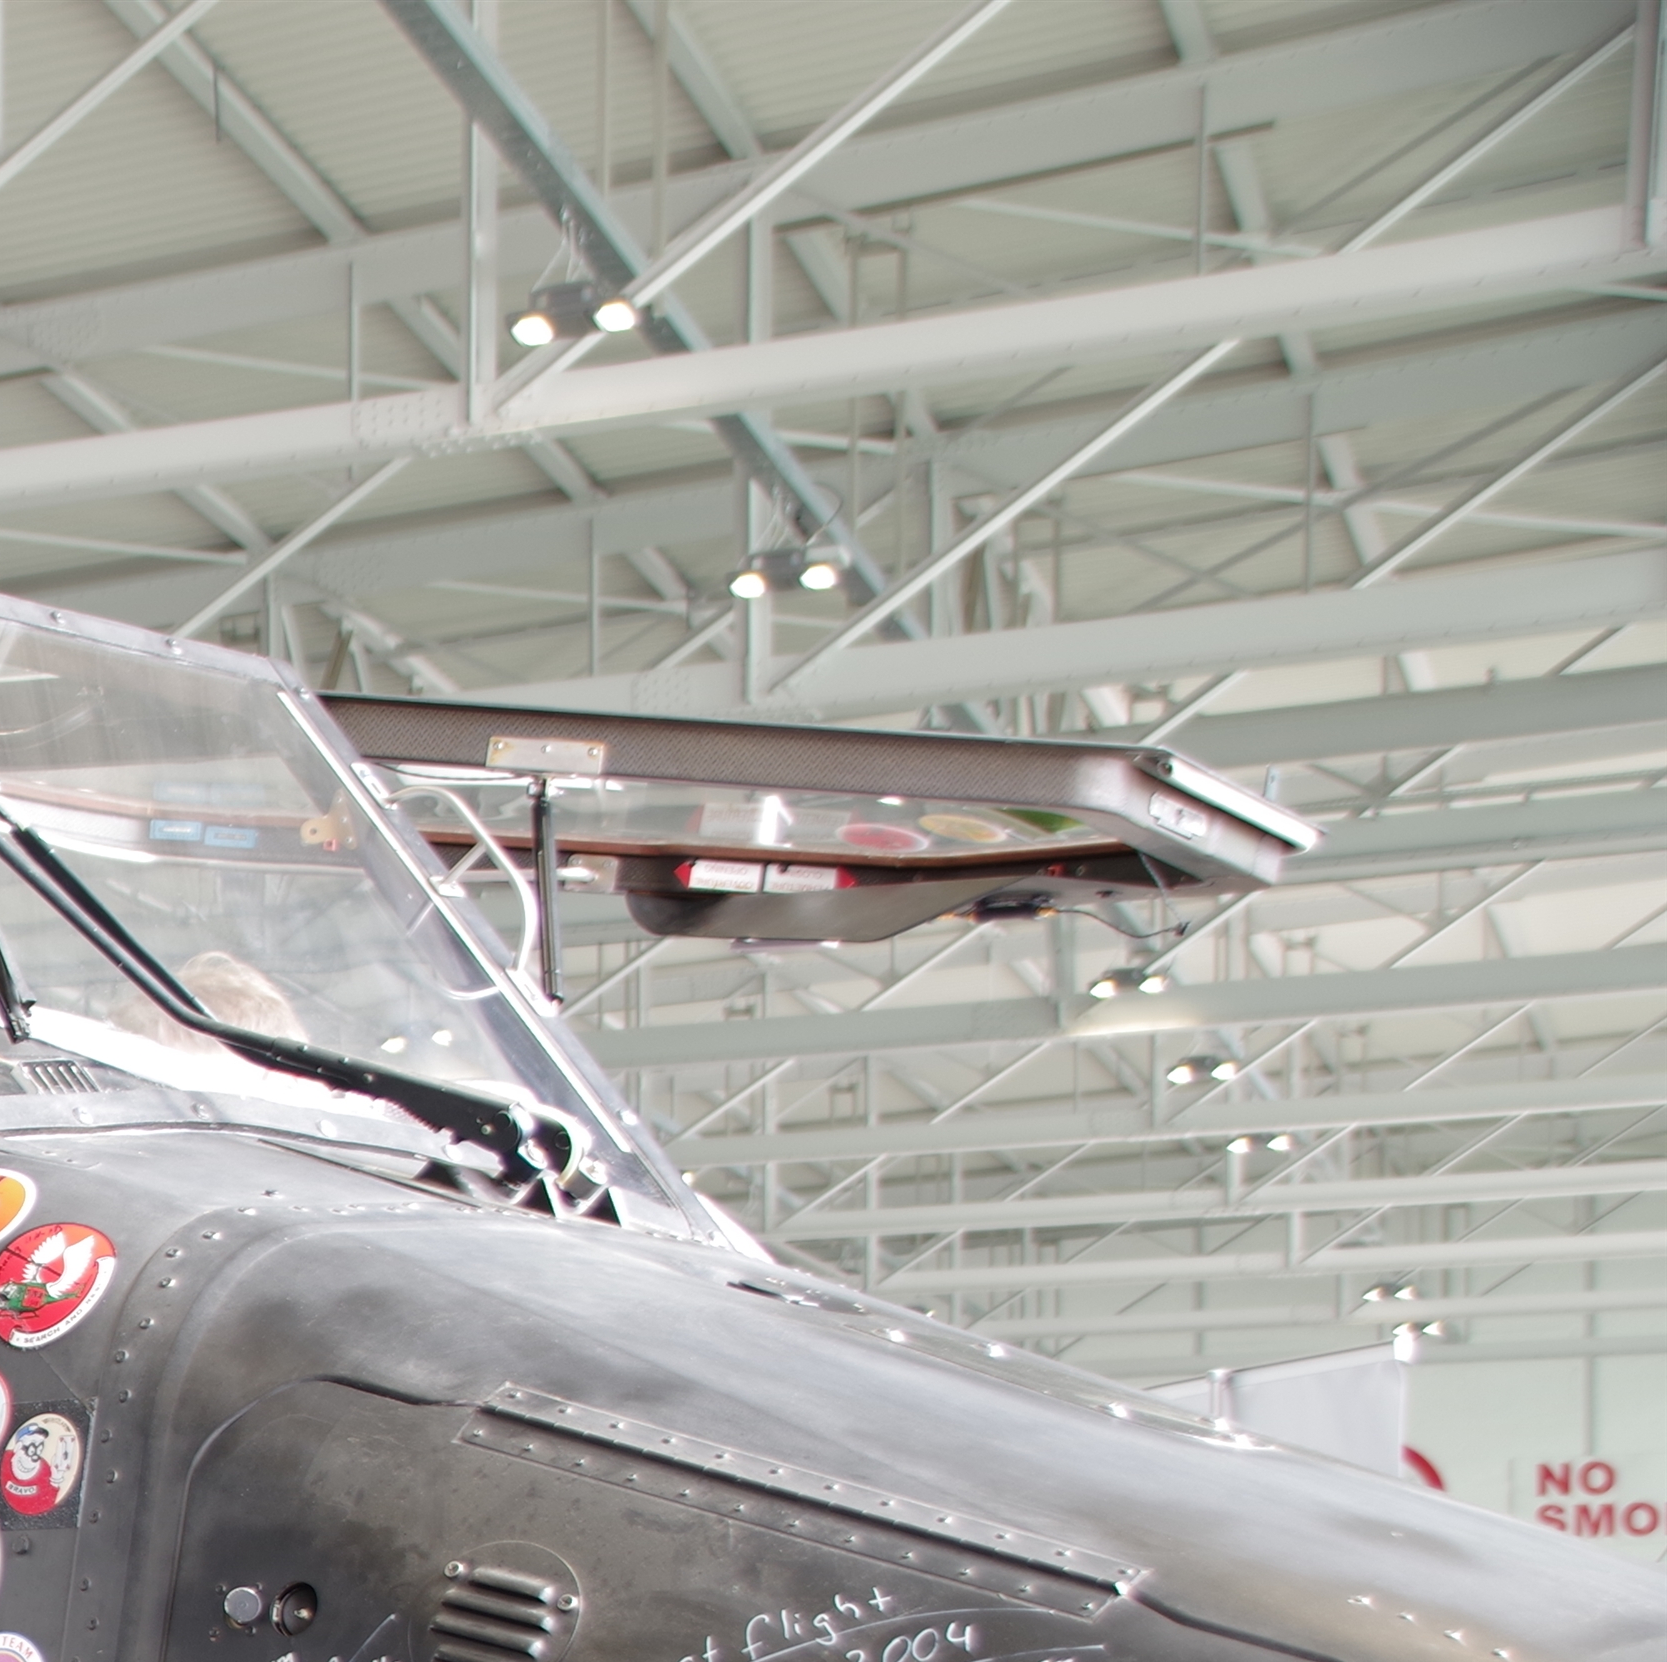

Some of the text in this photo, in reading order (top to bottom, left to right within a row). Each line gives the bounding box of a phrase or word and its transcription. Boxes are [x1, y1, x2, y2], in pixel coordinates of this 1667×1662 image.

[23, 1326, 61, 1344] SEARCH
[64, 1308, 84, 1327] AND
[1535, 1461, 1617, 1496] NO
[741, 1586, 893, 1661] flight
[2, 1635, 34, 1660] TEAM
